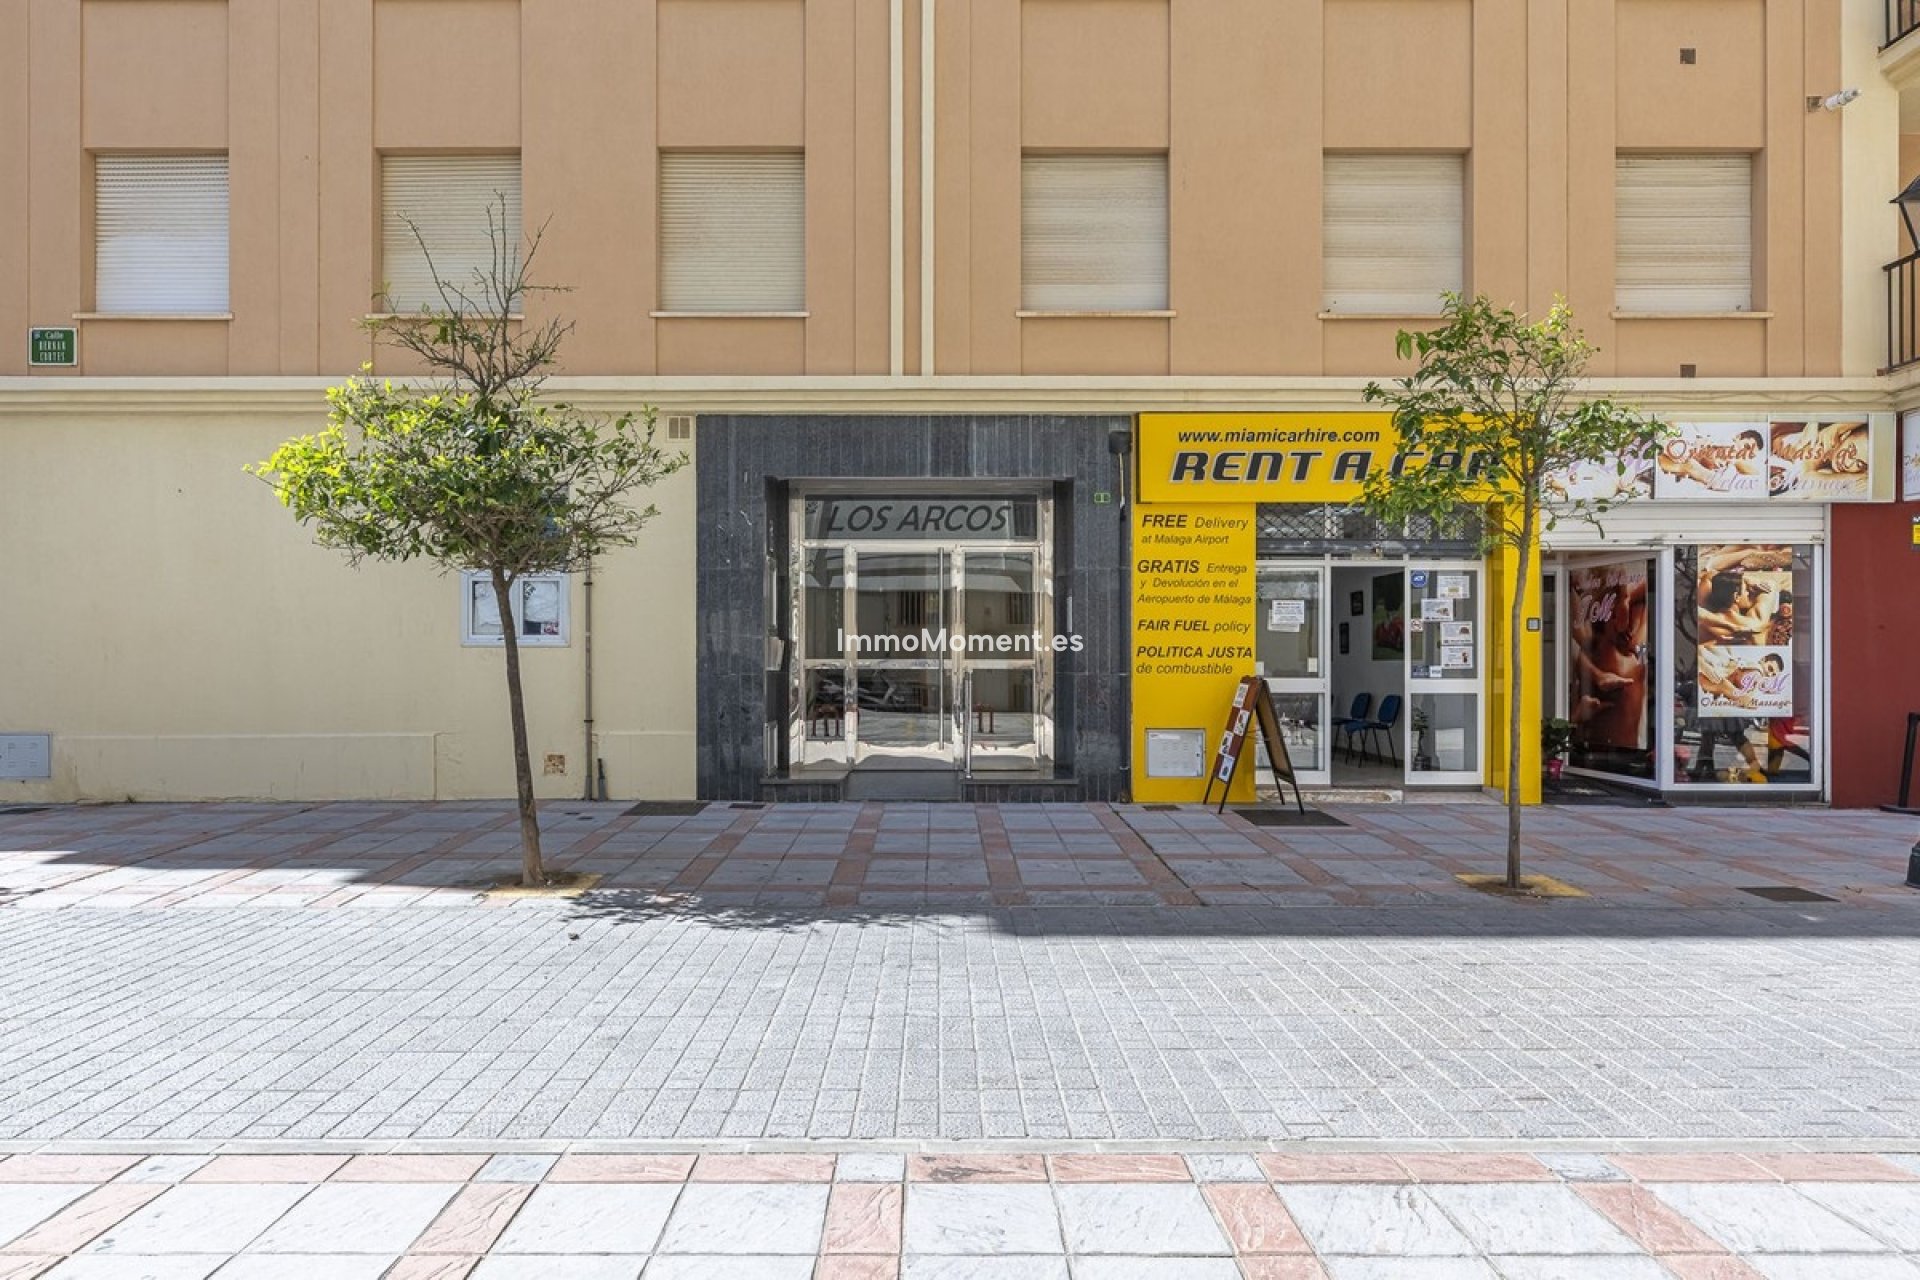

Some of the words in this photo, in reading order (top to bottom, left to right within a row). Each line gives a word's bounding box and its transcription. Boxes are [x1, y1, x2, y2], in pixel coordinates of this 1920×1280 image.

[45, 331, 64, 340] Calle
[1178, 428, 1380, 443] www.miamicarhire.com
[1169, 450, 1323, 483] RENT
[1330, 450, 1373, 483] A
[827, 505, 892, 532] LOS
[896, 505, 1012, 532] ARCOS
[1142, 515, 1188, 528] FREE
[1194, 517, 1248, 531] Delivery
[1141, 535, 1152, 544] at
[1154, 534, 1192, 545] Malaga
[1193, 534, 1229, 545] Airport
[1137, 559, 1200, 573] GRATIS
[1206, 562, 1247, 574] Entrega
[1140, 580, 1146, 589] y
[1212, 580, 1227, 588] en
[1228, 578, 1238, 588] el
[1137, 594, 1195, 605] Aeropuerto
[1197, 594, 1211, 604] de
[1137, 619, 1170, 631] FAIR
[1173, 619, 1210, 631] FUEL
[1213, 620, 1251, 634] policy
[1136, 645, 1203, 658] POLITICA
[1207, 646, 1252, 659] JUSTA
[1135, 663, 1152, 674] de
[1156, 663, 1233, 675] combustible
